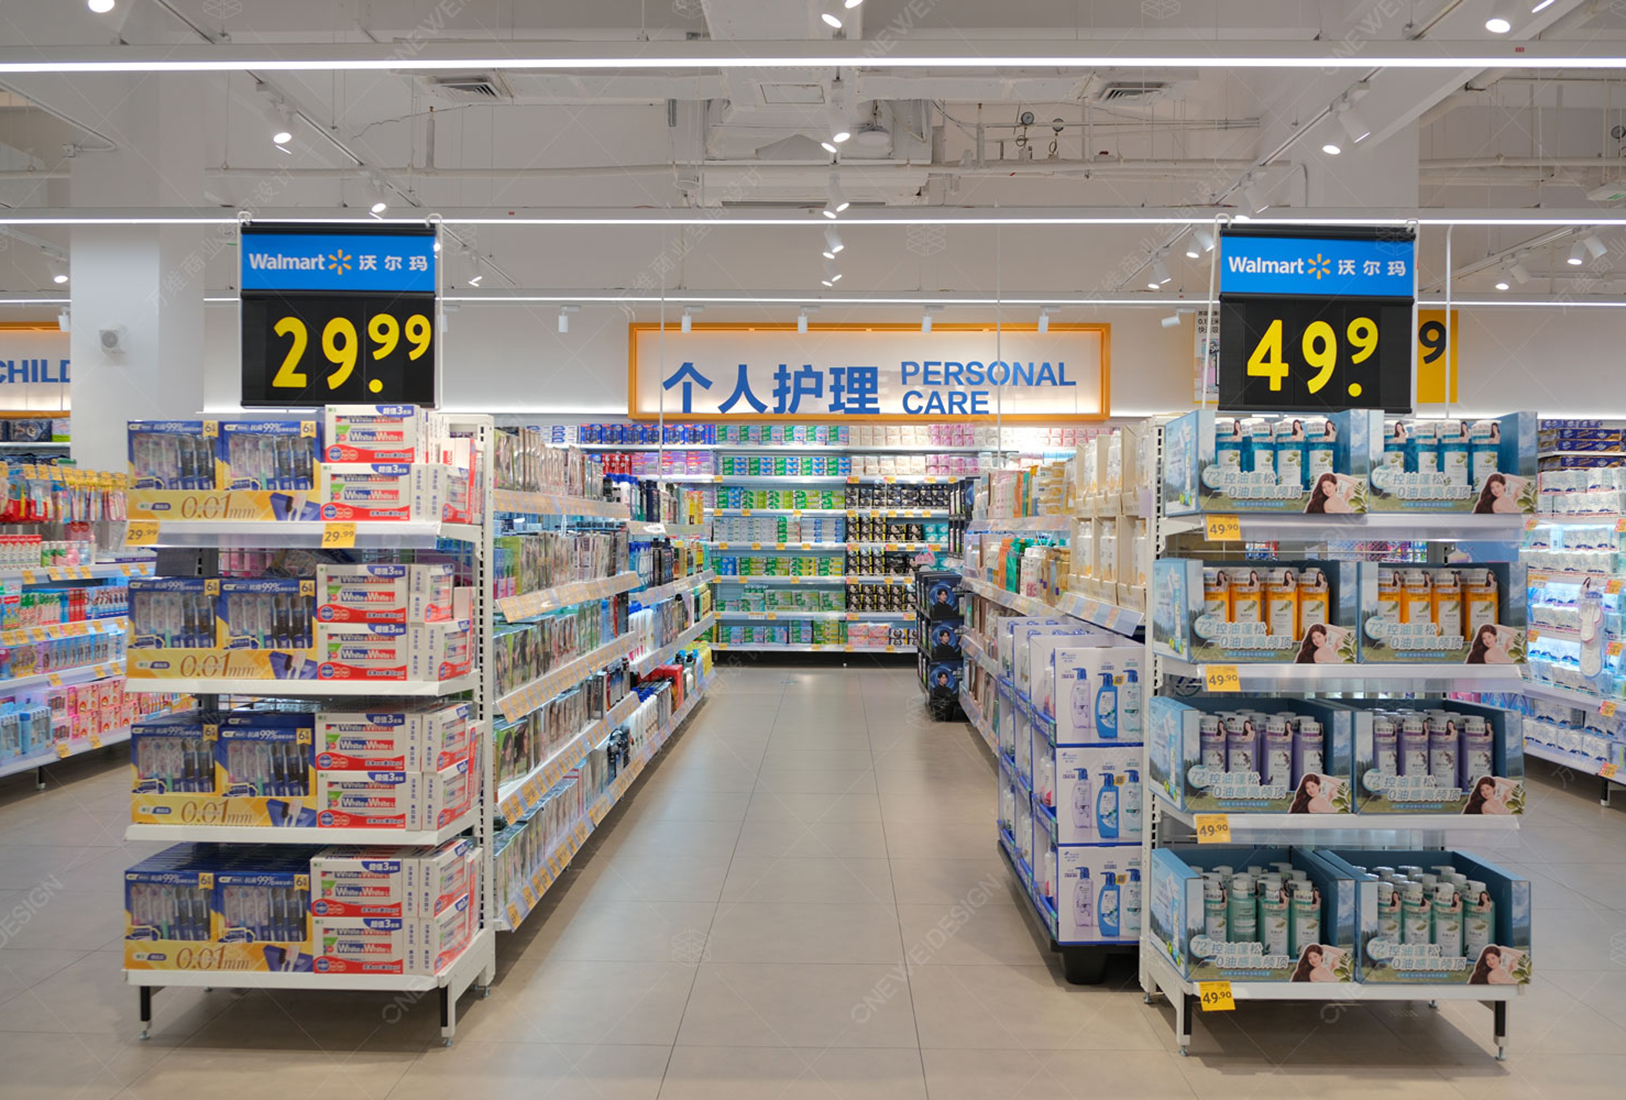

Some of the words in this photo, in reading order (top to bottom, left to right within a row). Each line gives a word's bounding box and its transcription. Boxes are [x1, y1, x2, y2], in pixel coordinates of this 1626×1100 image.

[248, 253, 325, 271] Walmart
[358, 254, 428, 272] 沃尔玛
[1228, 256, 1305, 275] Walmart
[1338, 259, 1406, 277] 沃尔玛
[272, 313, 432, 394] 29.99
[901, 361, 1077, 387] PERSONAL
[662, 362, 881, 415] 个人护理
[902, 390, 991, 415] CARE
